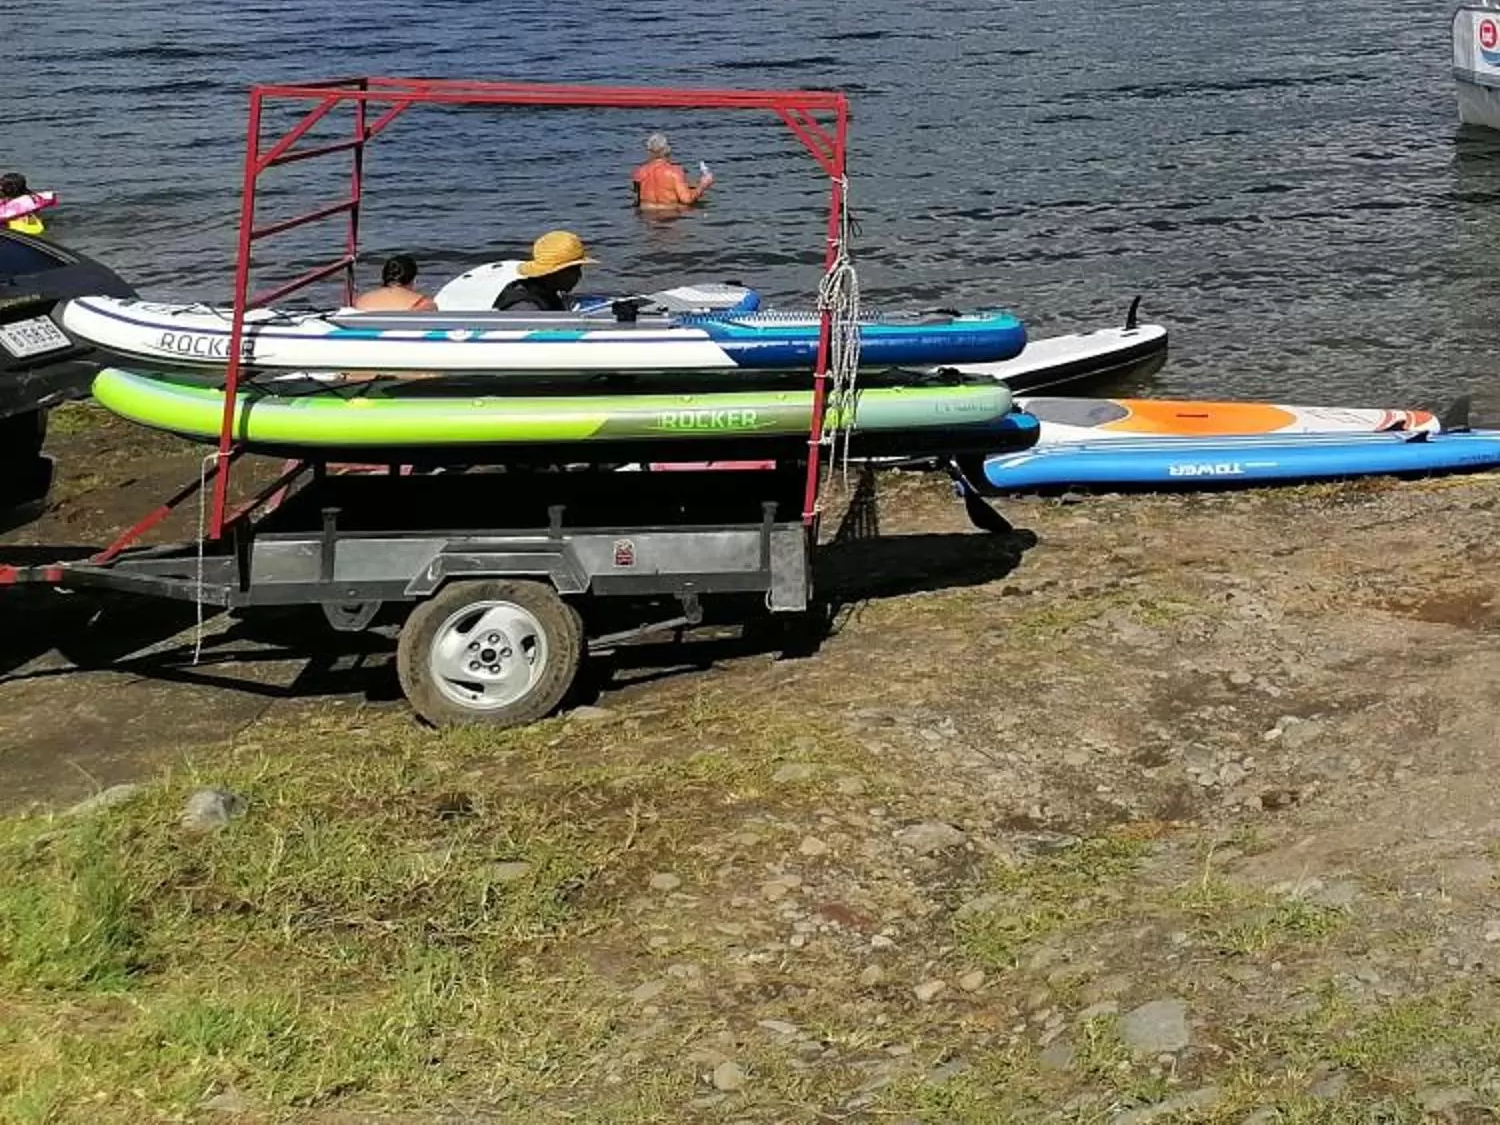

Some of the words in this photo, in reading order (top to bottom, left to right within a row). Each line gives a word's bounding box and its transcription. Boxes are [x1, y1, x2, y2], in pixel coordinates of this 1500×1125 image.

[160, 331, 257, 357] ROCKR
[659, 408, 758, 431] ROCKER
[1168, 462, 1246, 476] TOWER
